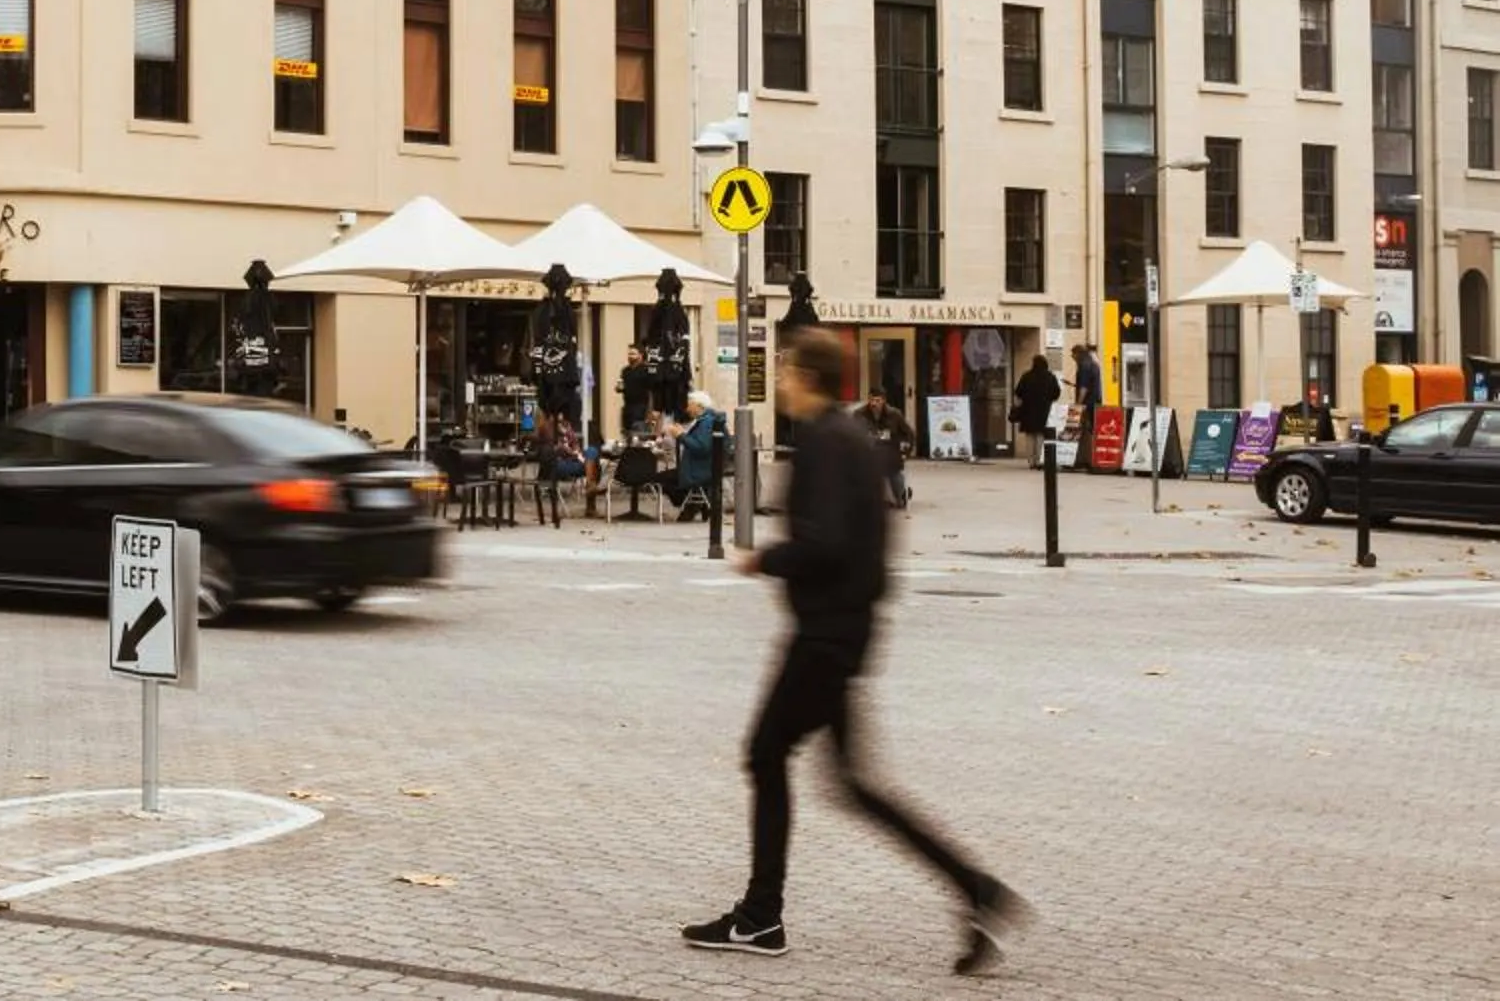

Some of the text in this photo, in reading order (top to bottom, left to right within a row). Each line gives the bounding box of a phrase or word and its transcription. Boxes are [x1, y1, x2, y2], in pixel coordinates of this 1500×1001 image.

[277, 62, 309, 75] DHL
[818, 301, 891, 318] GALLERIA
[909, 304, 995, 320] SALAMANCA
[120, 531, 161, 559] KEEP
[120, 564, 159, 591] LEFT
